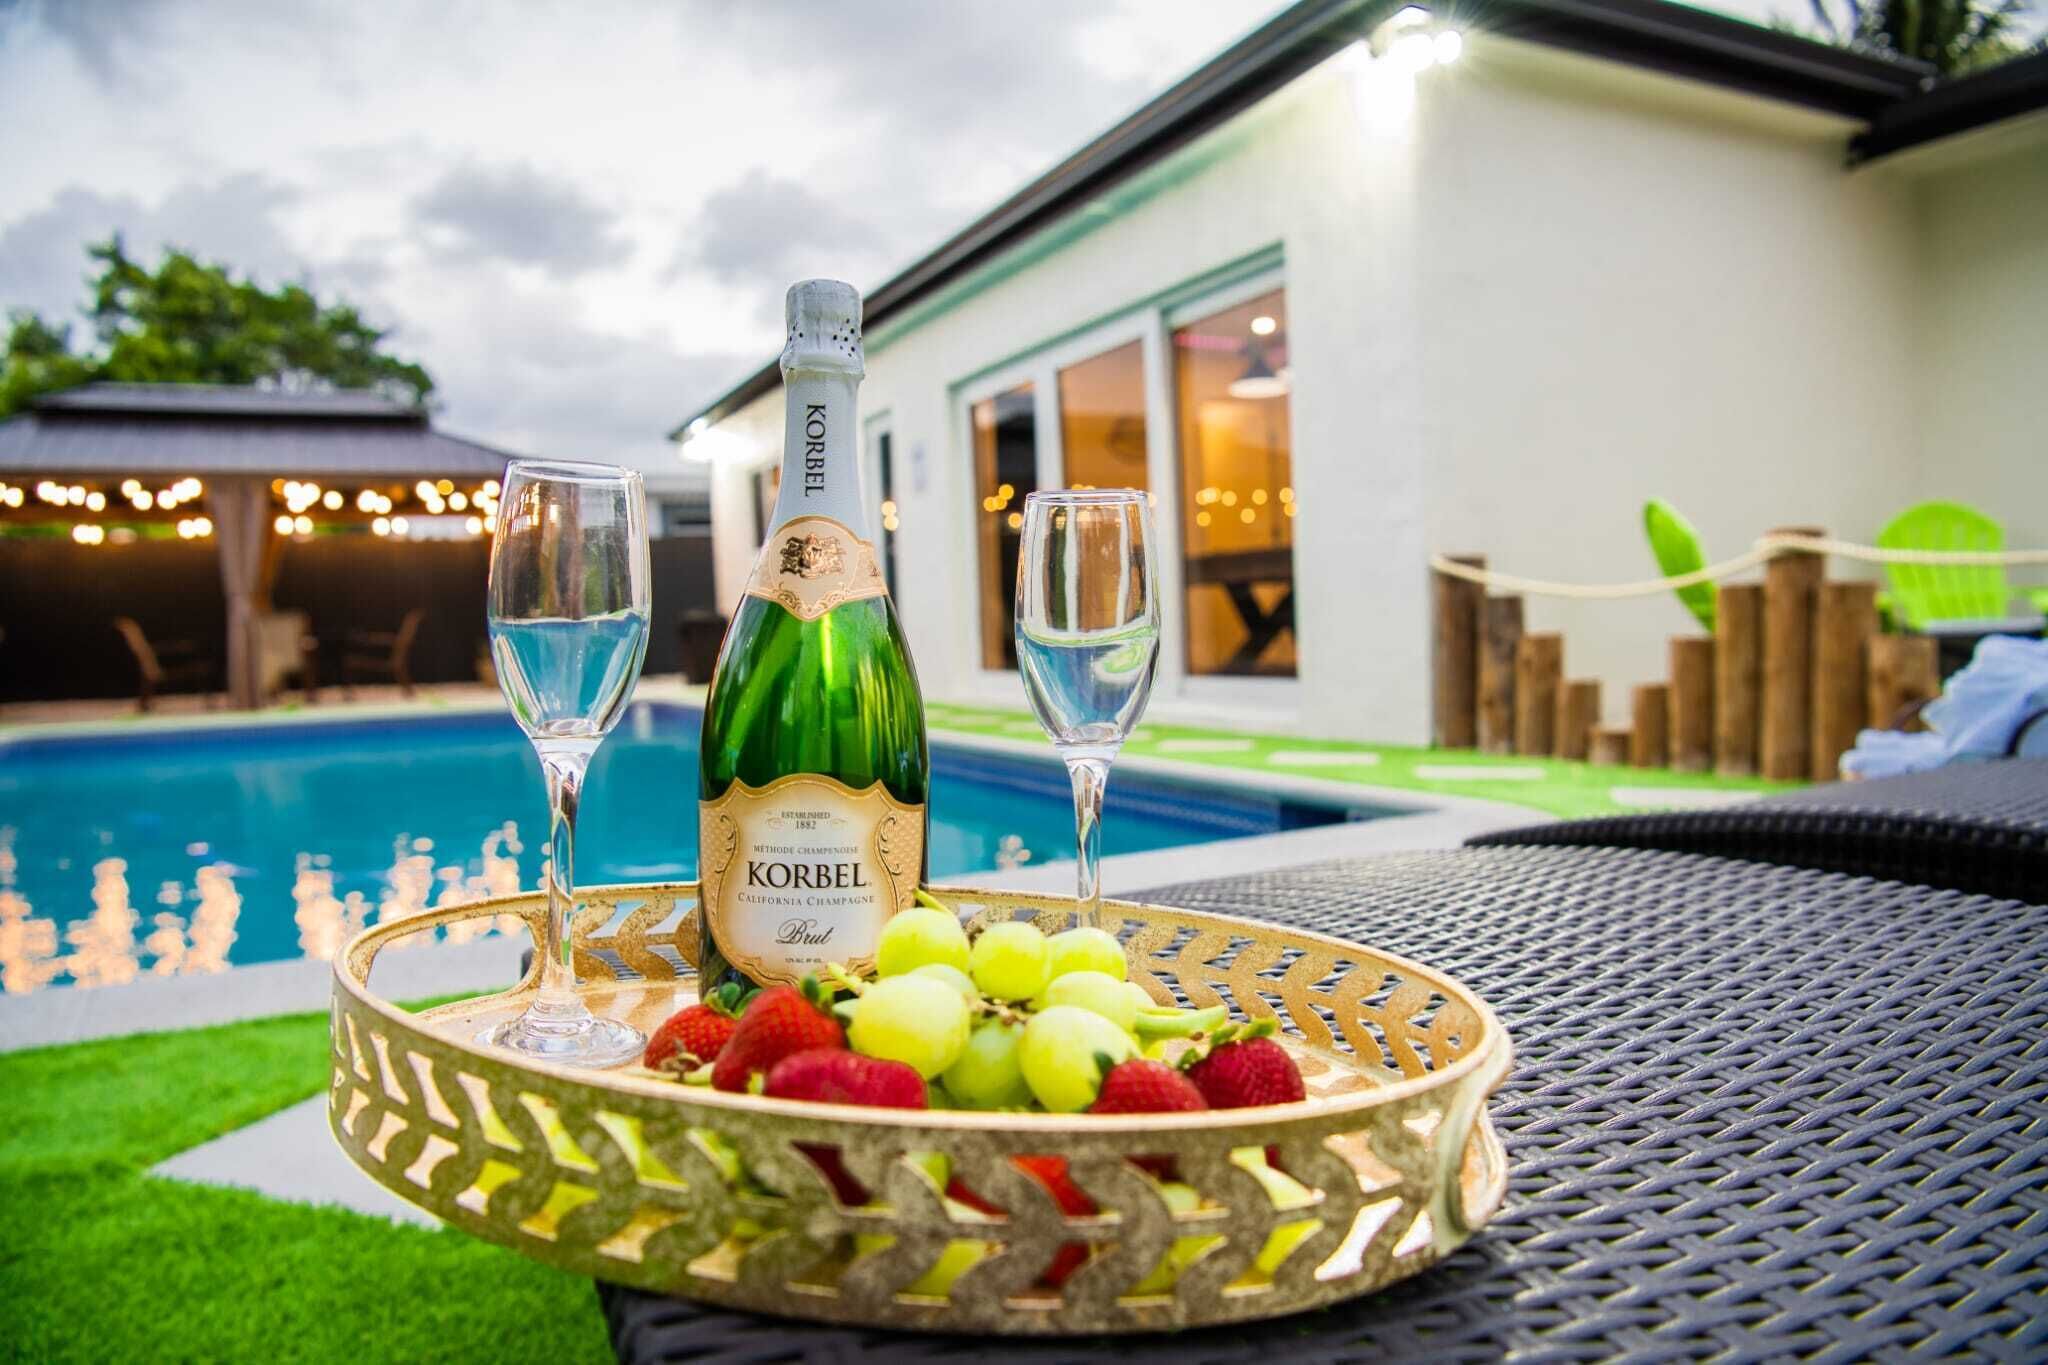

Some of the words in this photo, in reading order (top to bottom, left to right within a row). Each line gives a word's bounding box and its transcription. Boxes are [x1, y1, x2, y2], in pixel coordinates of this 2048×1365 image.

[805, 404, 826, 497] KORBEL
[781, 811, 830, 819] ESTABLISHED
[796, 821, 816, 829] 1882
[797, 846, 859, 855] CHAMPENOISE
[748, 861, 867, 888] KORBEL
[776, 918, 834, 945] Brut
